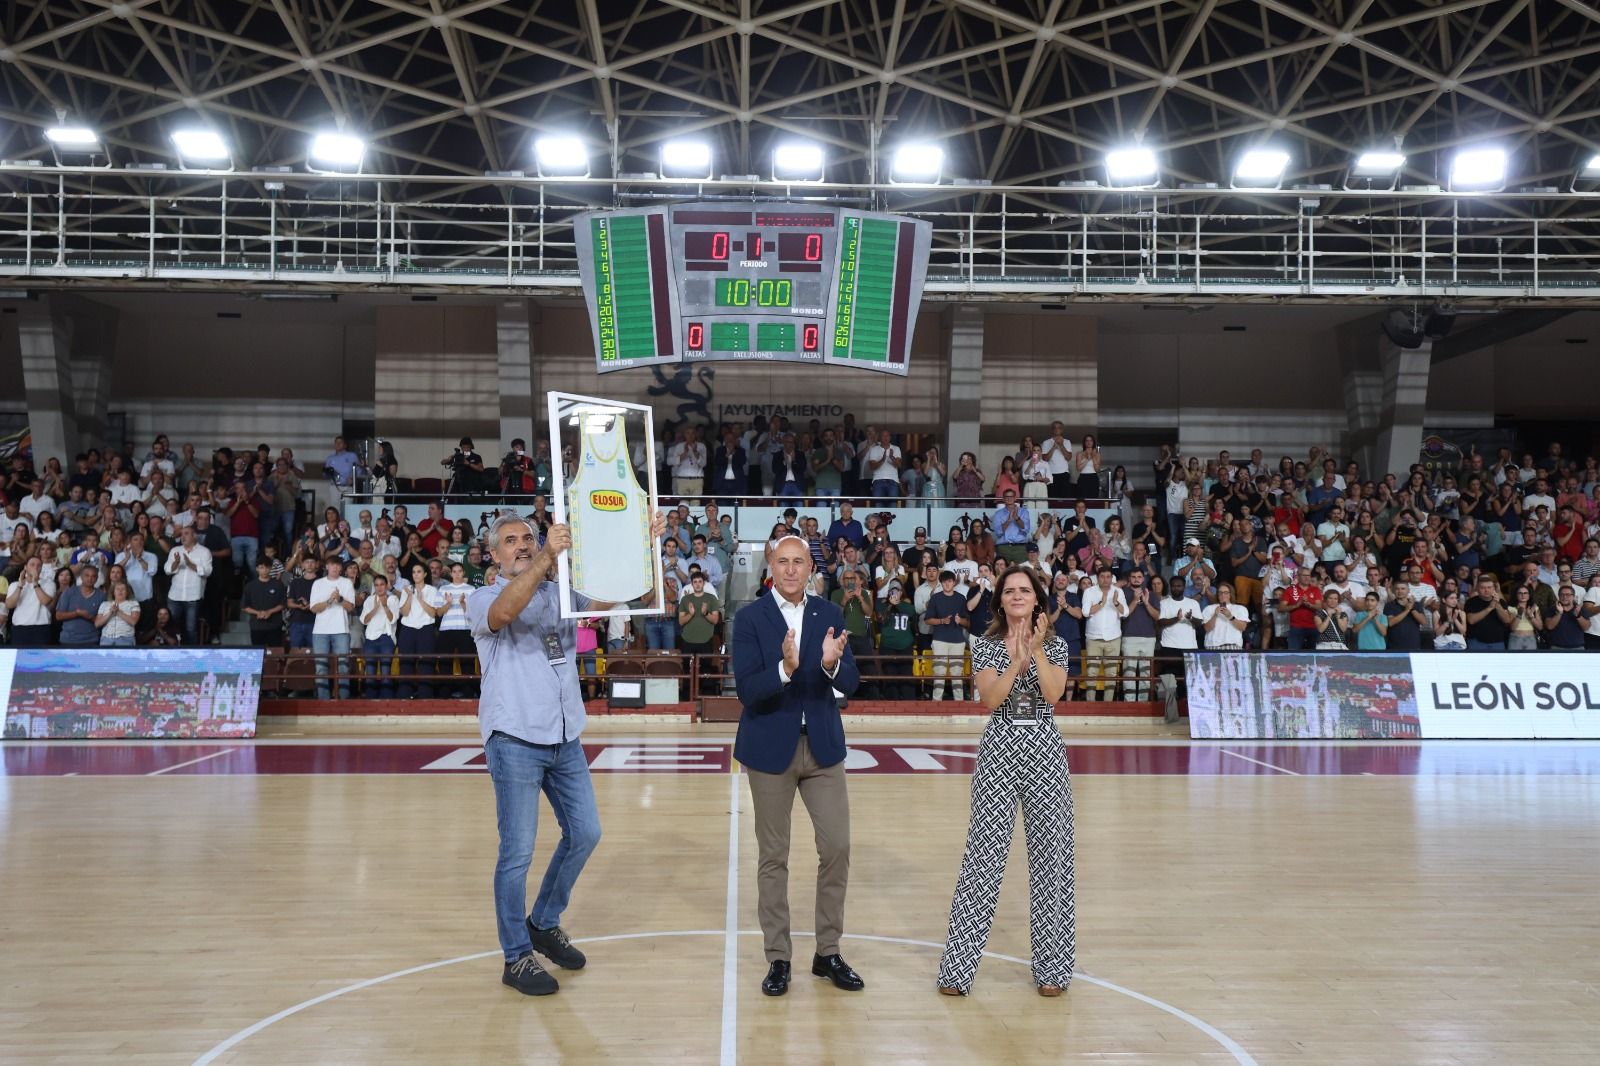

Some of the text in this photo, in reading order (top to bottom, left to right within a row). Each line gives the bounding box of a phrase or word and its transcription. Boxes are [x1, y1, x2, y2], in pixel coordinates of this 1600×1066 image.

[599, 229, 606, 240] 2
[601, 240, 607, 250] 3
[712, 233, 728, 260] 0
[756, 237, 761, 257] 1
[805, 234, 821, 261] 0
[850, 239, 857, 249] 2
[601, 251, 608, 261] 4
[849, 250, 855, 260] 5
[602, 262, 609, 272] 6
[841, 260, 855, 271] 10
[603, 273, 610, 283] 7
[840, 271, 854, 282] 11
[603, 283, 611, 294] 8
[726, 280, 791, 306] 10:00
[840, 282, 853, 293] 12
[598, 295, 611, 305] 12
[839, 293, 852, 303] 14
[600, 306, 612, 316] 20
[838, 304, 851, 314] 16
[600, 316, 613, 327] 23
[837, 315, 850, 326] 19
[601, 328, 614, 338] 24
[836, 325, 849, 336] 25
[689, 326, 703, 348] 0
[804, 327, 818, 349] 0
[835, 336, 849, 347] 60
[602, 339, 615, 349] 30
[603, 350, 616, 360] 33
[601, 359, 634, 367] MONDO
[872, 361, 905, 370] MONDO
[724, 404, 843, 417] AYUNTAMIENTO
[617, 459, 626, 479] 5
[592, 494, 624, 506] ELOSUA
[738, 557, 746, 566] C
[894, 615, 909, 631] 10
[1431, 675, 1600, 710] LEÓN SOL
